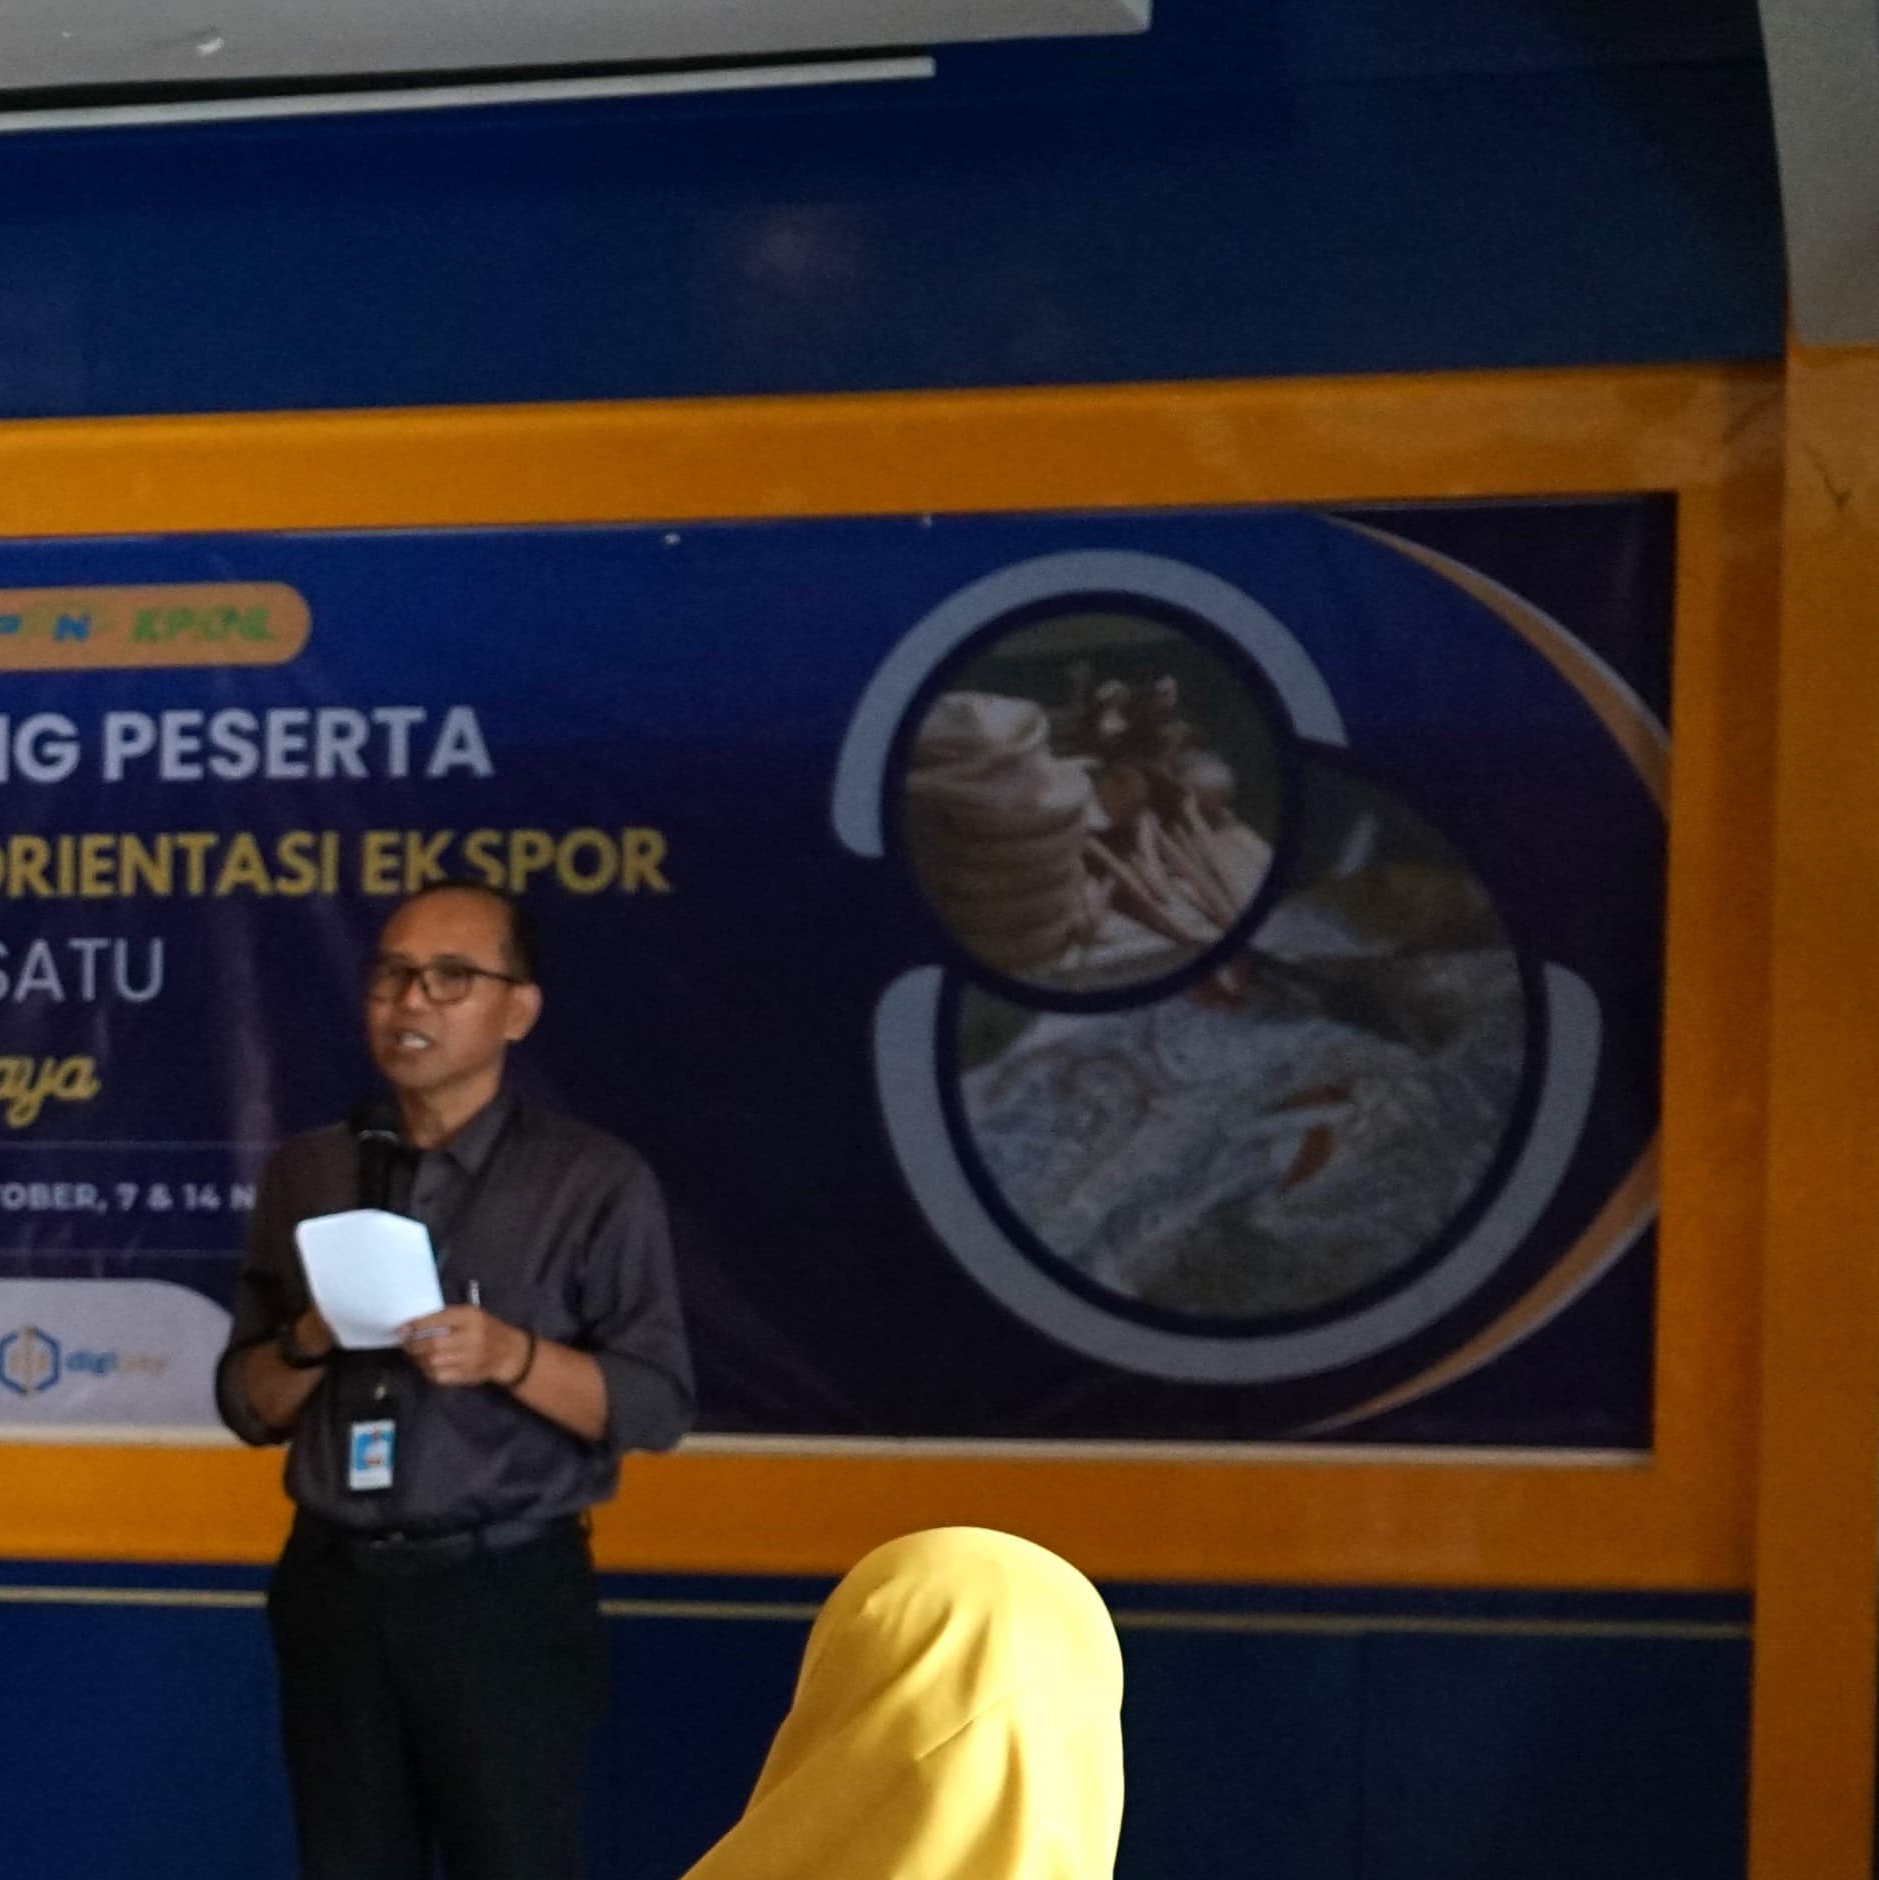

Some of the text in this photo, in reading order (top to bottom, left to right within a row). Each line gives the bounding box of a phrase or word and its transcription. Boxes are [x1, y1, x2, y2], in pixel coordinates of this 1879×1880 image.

[103, 706, 494, 781] PESERTA
[362, 828, 669, 895] EKSPOR
[115, 1182, 138, 1210] 7
[146, 1182, 173, 1209] &
[182, 1182, 221, 1209] 14
